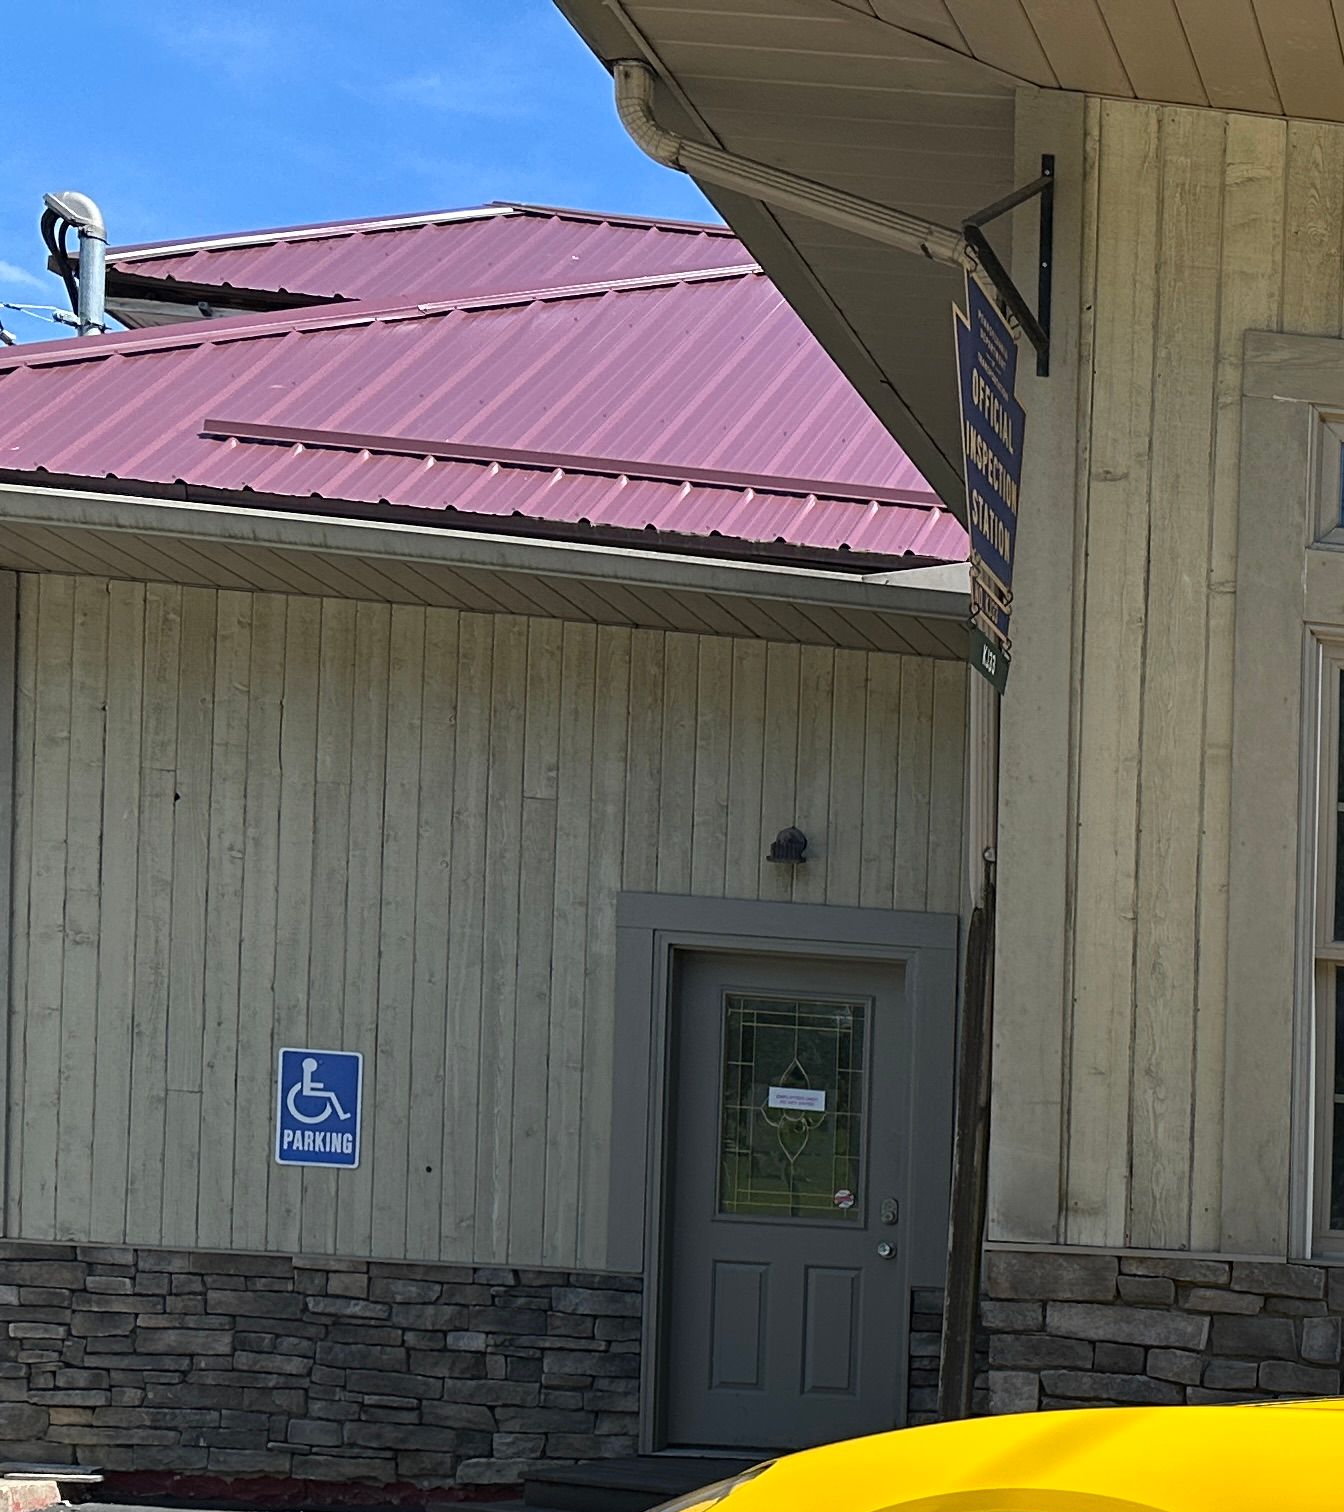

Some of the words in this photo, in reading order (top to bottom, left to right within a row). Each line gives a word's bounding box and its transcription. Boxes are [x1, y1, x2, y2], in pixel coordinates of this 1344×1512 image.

[972, 367, 1015, 455] OFFICIAL
[966, 420, 1018, 517] INSPECTION
[971, 488, 1011, 564] STATION
[282, 1129, 353, 1154] PARKING
